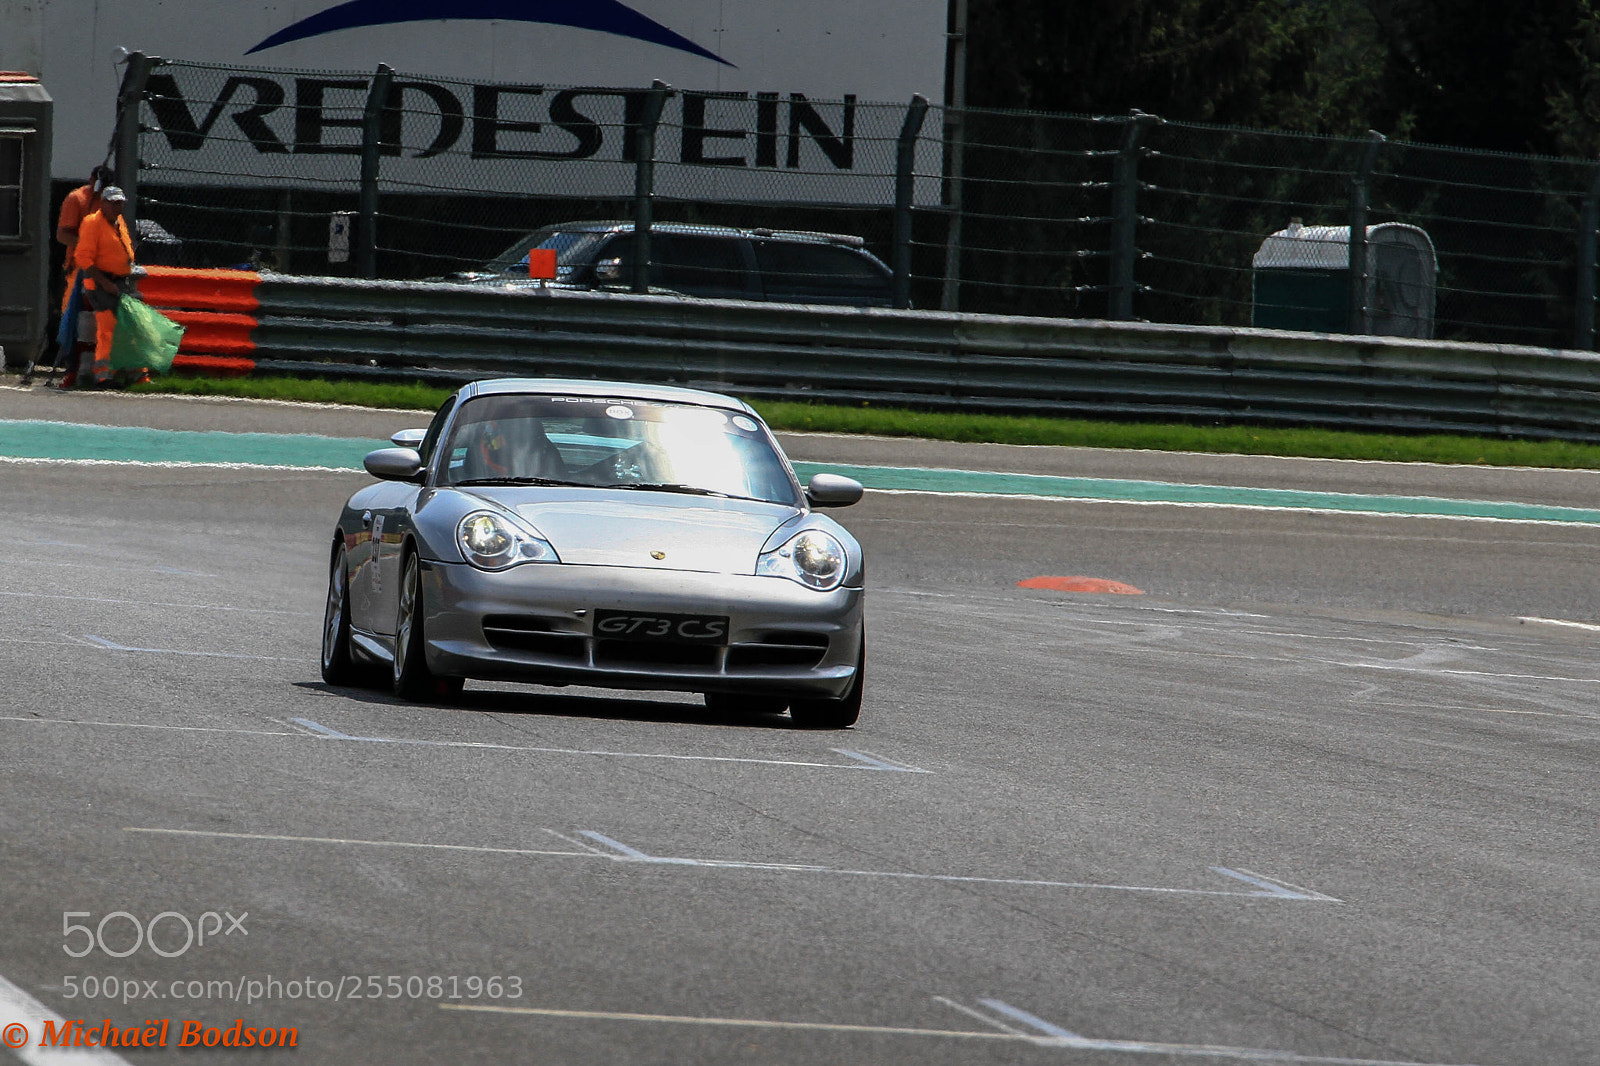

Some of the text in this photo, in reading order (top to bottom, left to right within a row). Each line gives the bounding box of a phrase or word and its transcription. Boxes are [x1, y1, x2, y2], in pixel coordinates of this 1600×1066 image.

[143, 74, 856, 169] VREDESTEIN
[551, 397, 649, 407] PORSCHE
[597, 616, 726, 638] GT3 CS
